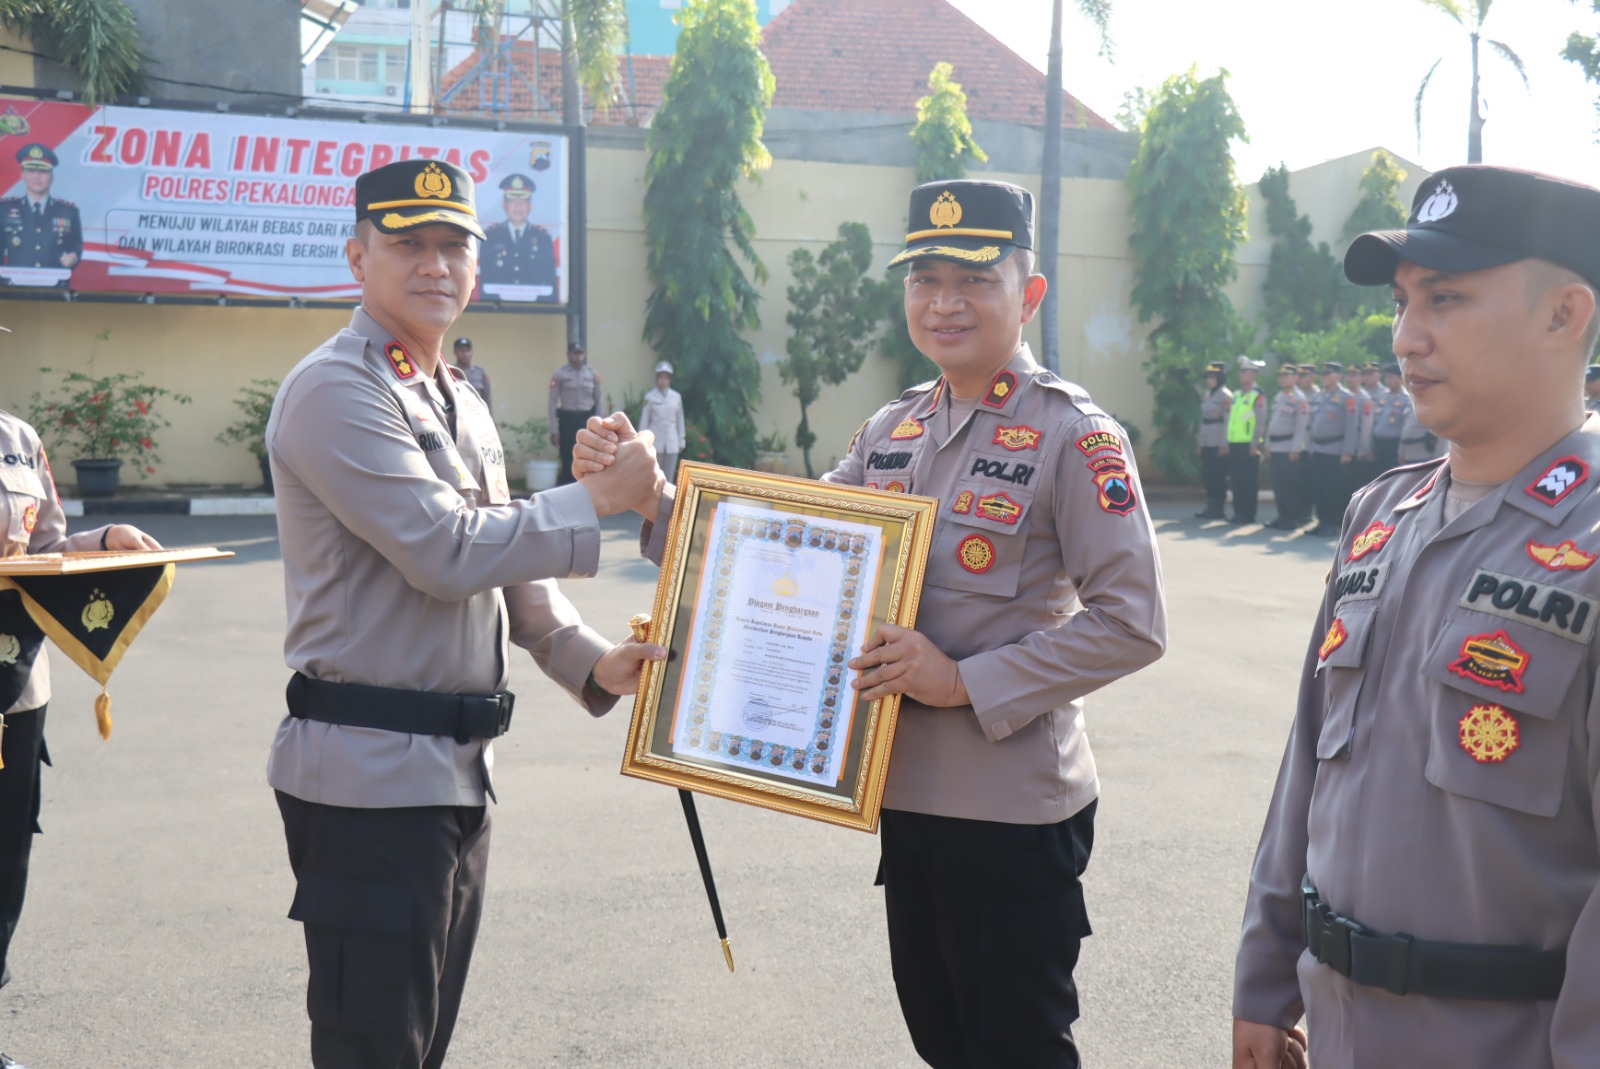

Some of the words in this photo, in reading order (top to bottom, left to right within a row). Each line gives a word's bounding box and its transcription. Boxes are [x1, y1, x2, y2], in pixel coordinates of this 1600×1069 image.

[90, 125, 211, 169] ZONA
[144, 175, 229, 200] POLRES
[234, 180, 357, 207] PEKALONGA
[138, 214, 196, 230] MENUJU
[201, 217, 258, 233] WILAYAH
[262, 219, 303, 236] BEBAS
[308, 223, 337, 237] DARI
[118, 236, 145, 250] DAN
[151, 237, 211, 254] WILAYAH
[215, 241, 285, 257] BIROKRASI
[291, 243, 340, 258] BERSIH
[1081, 433, 1120, 449] POLRES
[970, 458, 1036, 486] POLRI
[747, 597, 774, 608] Piagam
[1466, 573, 1590, 635] POLRI
